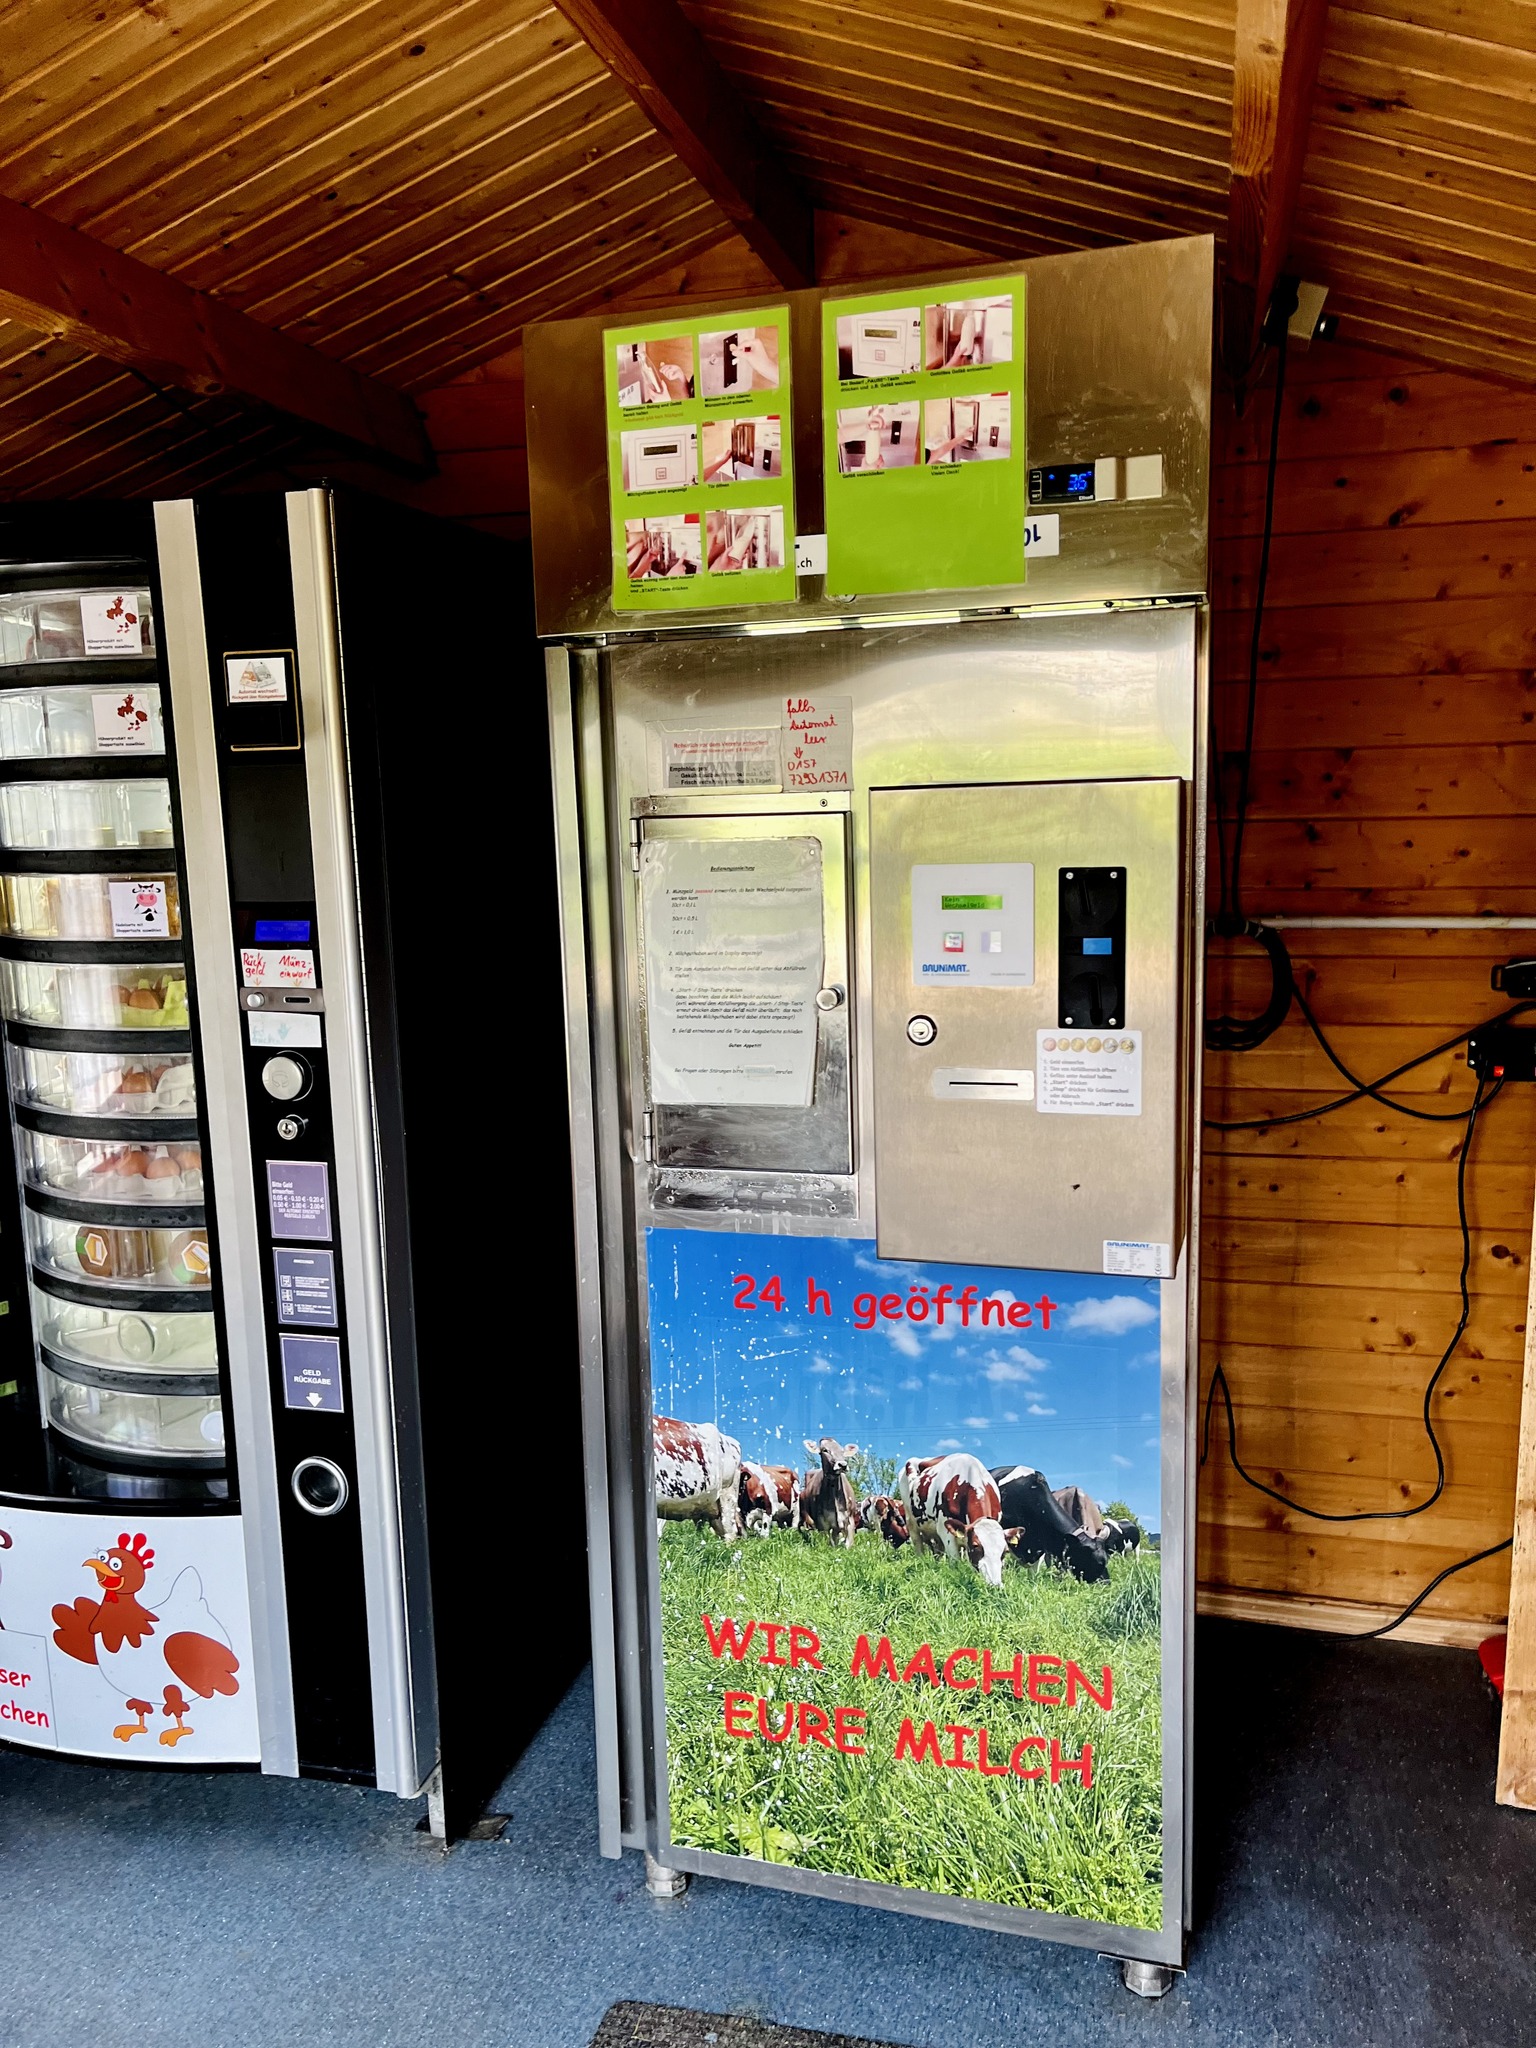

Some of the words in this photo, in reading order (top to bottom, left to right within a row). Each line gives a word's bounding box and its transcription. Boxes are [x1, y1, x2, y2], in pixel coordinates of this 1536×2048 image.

[786, 758, 817, 772] 0157
[244, 962, 266, 978] geld
[732, 1273, 787, 1313] 24
[806, 1276, 832, 1317] h
[852, 1283, 1058, 1331] geöffnet
[293, 1375, 332, 1386] RÜCKGABE
[302, 1368, 322, 1377] GELD
[701, 1614, 825, 1671] WIR
[850, 1633, 1113, 1712] MACHEN
[723, 1690, 867, 1757] EURE
[894, 1717, 1094, 1790] MILCH
